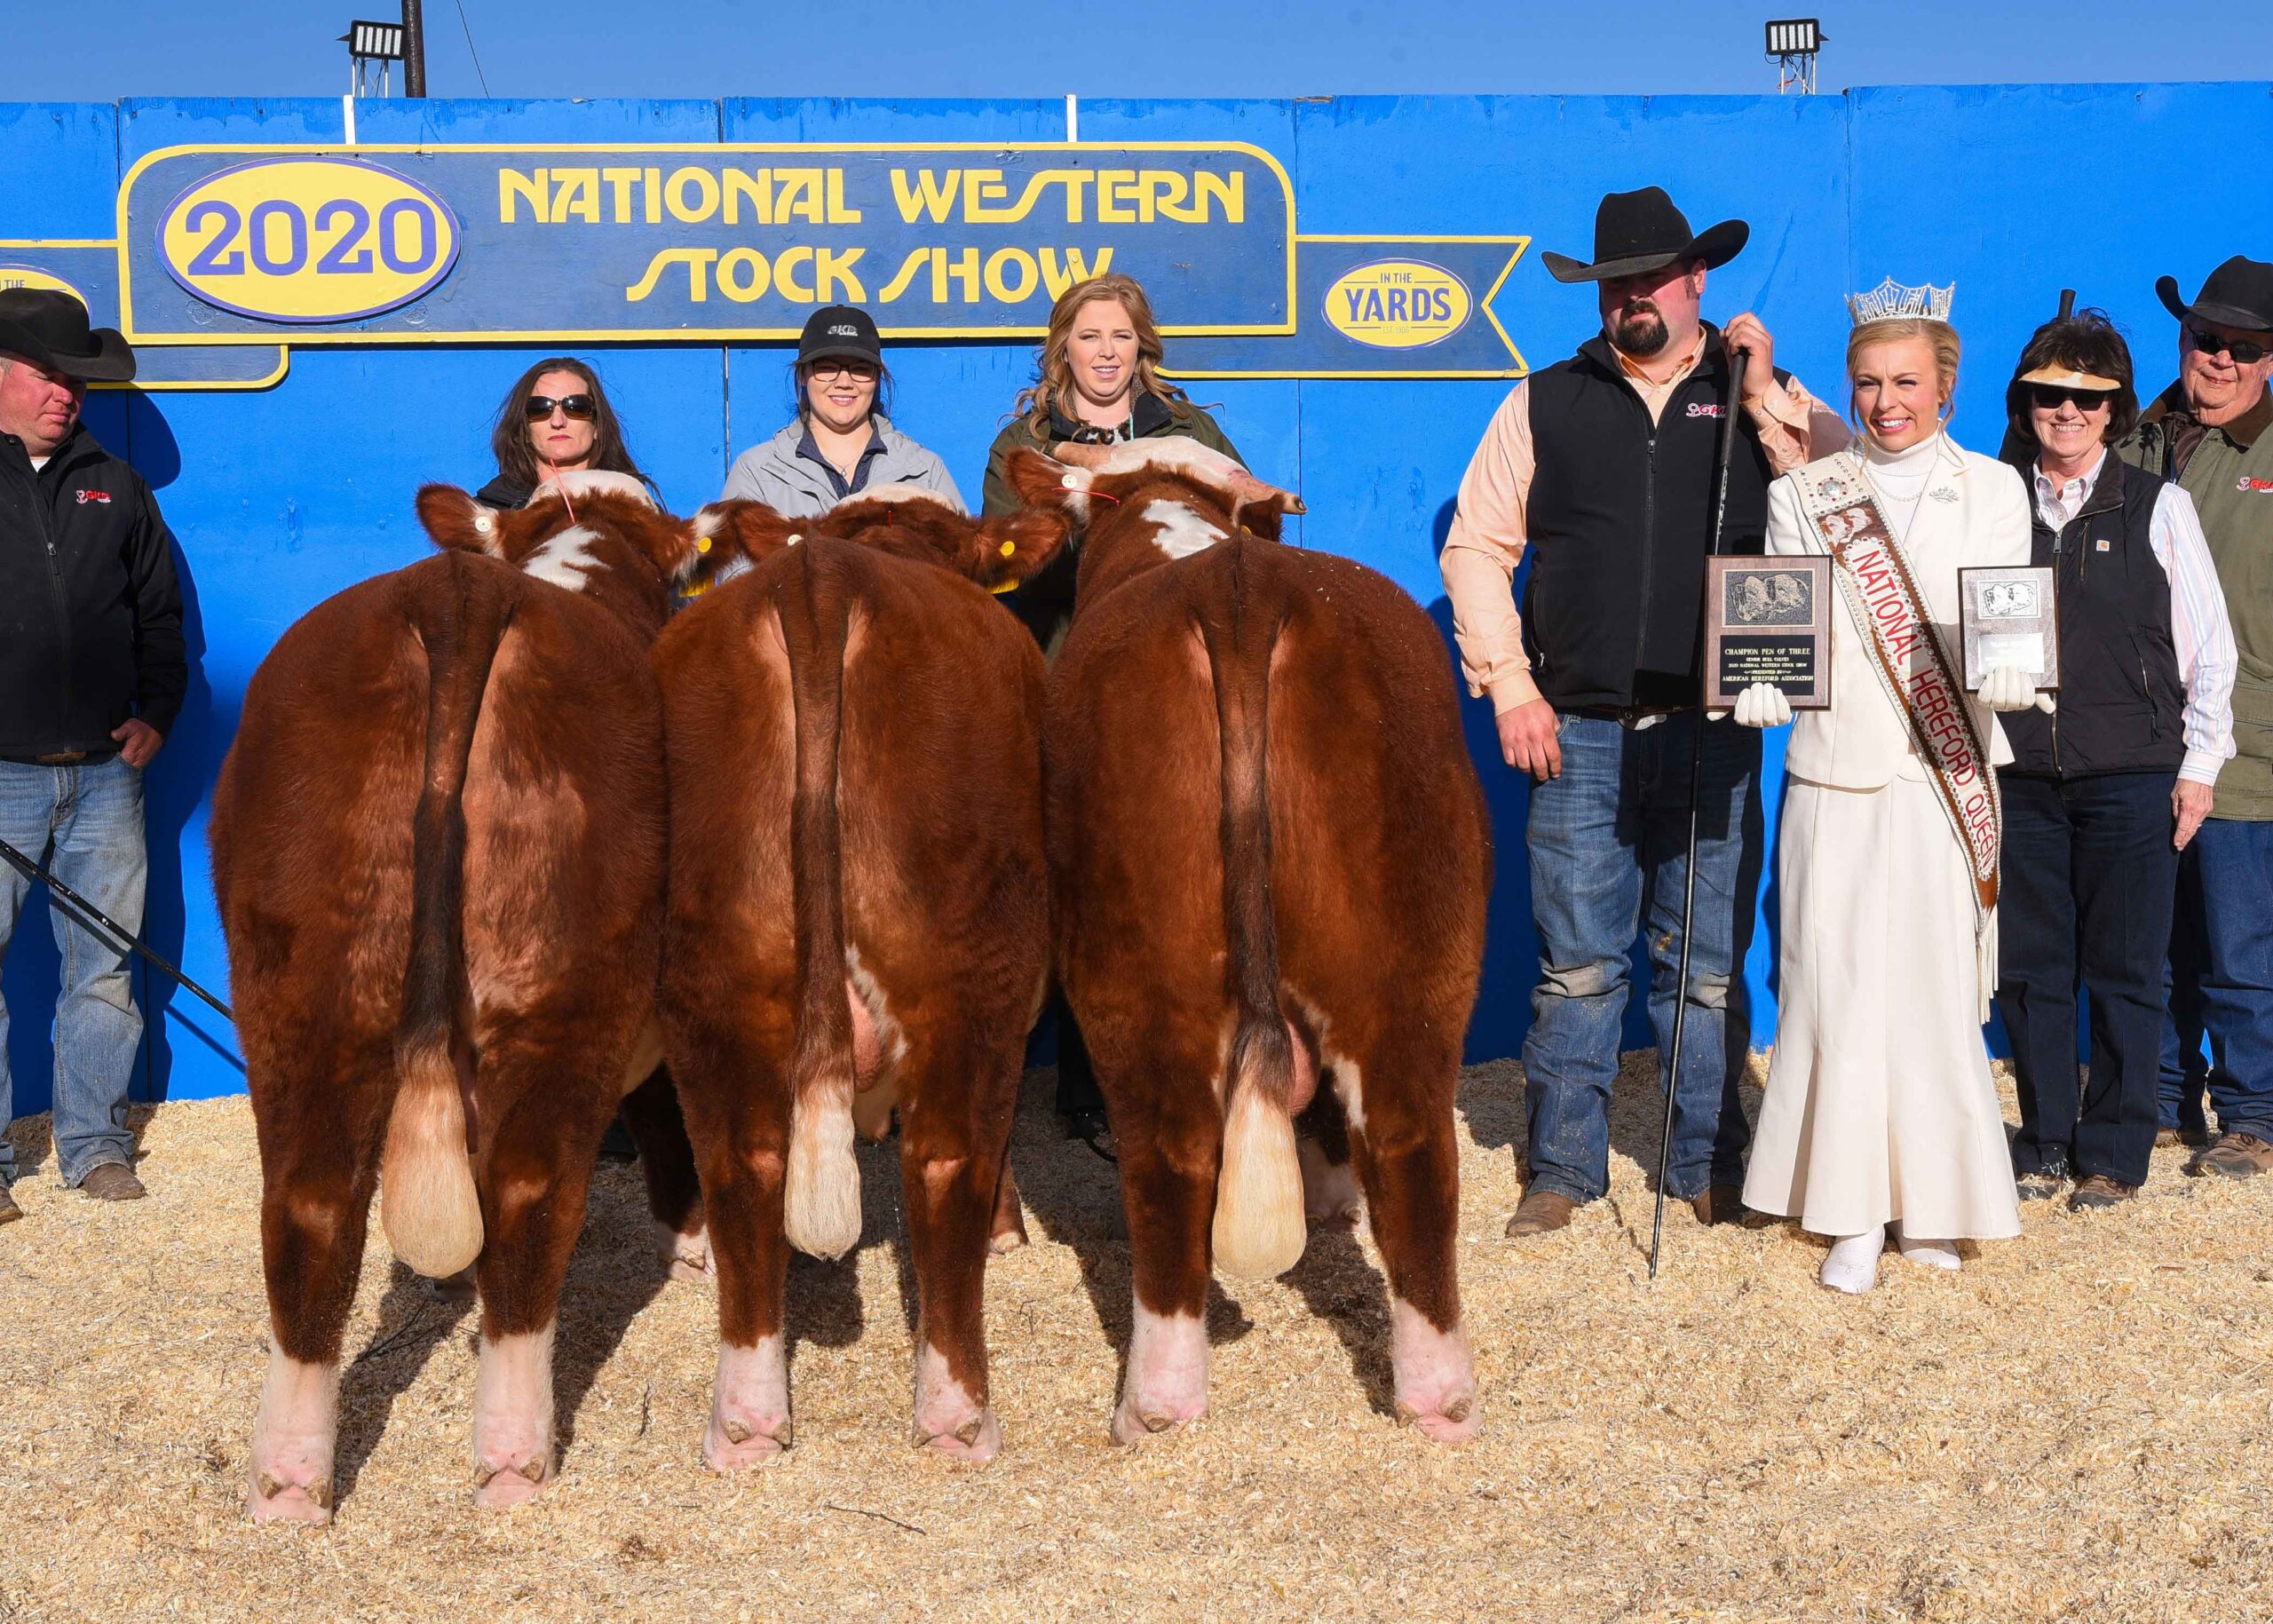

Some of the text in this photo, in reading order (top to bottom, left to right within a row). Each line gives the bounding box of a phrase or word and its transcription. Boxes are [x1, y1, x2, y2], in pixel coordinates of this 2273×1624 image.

[499, 168, 1244, 224] NATIONAL WESTERN
[185, 198, 438, 277] 2020
[626, 246, 1114, 304] STOCK SHOW
[1380, 272, 1413, 284] IN THE
[1344, 287, 1452, 322] YARDS
[1851, 549, 1998, 871] NATIONAL HEREFORD QUEEN
